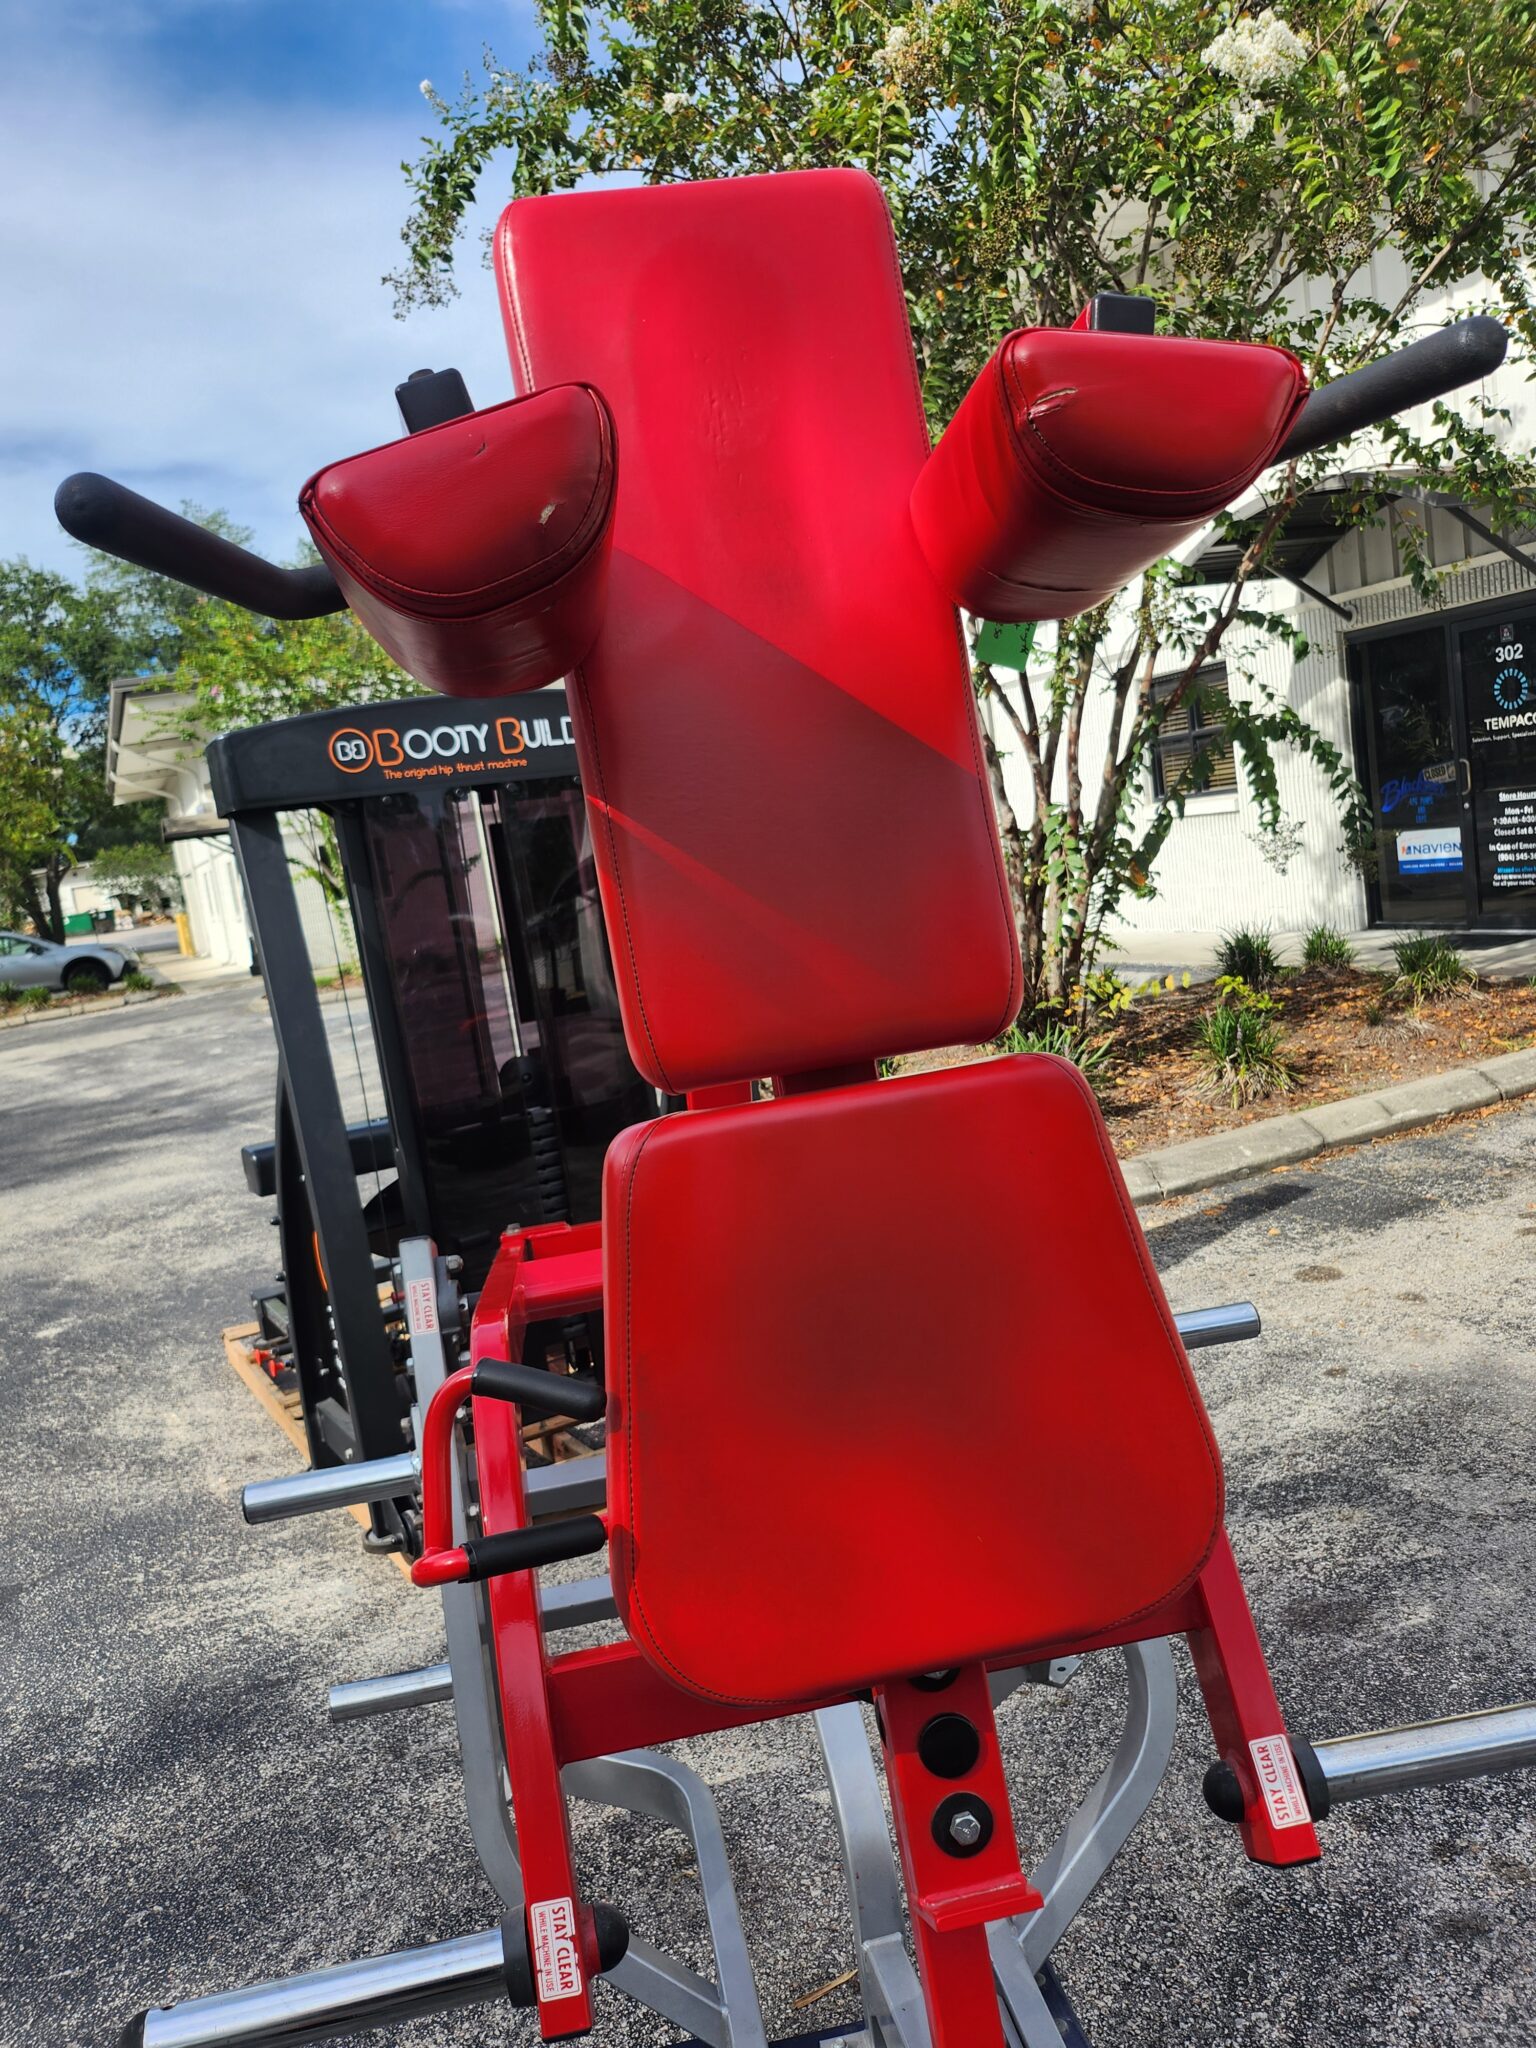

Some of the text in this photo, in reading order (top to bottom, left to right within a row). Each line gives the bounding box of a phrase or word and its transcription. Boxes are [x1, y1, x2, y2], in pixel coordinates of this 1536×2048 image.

[1495, 643, 1524, 663] 302
[372, 723, 489, 767] BOOTY
[383, 757, 528, 780] The original hip thrust machine
[1424, 766, 1446, 780] CLOSED
[1498, 792, 1516, 802] Store
[1504, 806, 1520, 816] Mon
[1524, 805, 1534, 814] Fri
[1494, 828, 1515, 837] Closed
[1516, 826, 1528, 836] Sat
[1488, 844, 1496, 852] In
[1496, 842, 1511, 851] Case
[1512, 842, 1518, 850] of
[421, 1282, 433, 1329] STAY CLEAR
[1257, 1745, 1290, 1821] STAY CLEAR
[1273, 1743, 1303, 1816] WHILE MACHINE IN USE
[538, 1911, 555, 1992] WHILE MACHINE IN USE
[552, 1906, 574, 1991] STAY CLEAR
